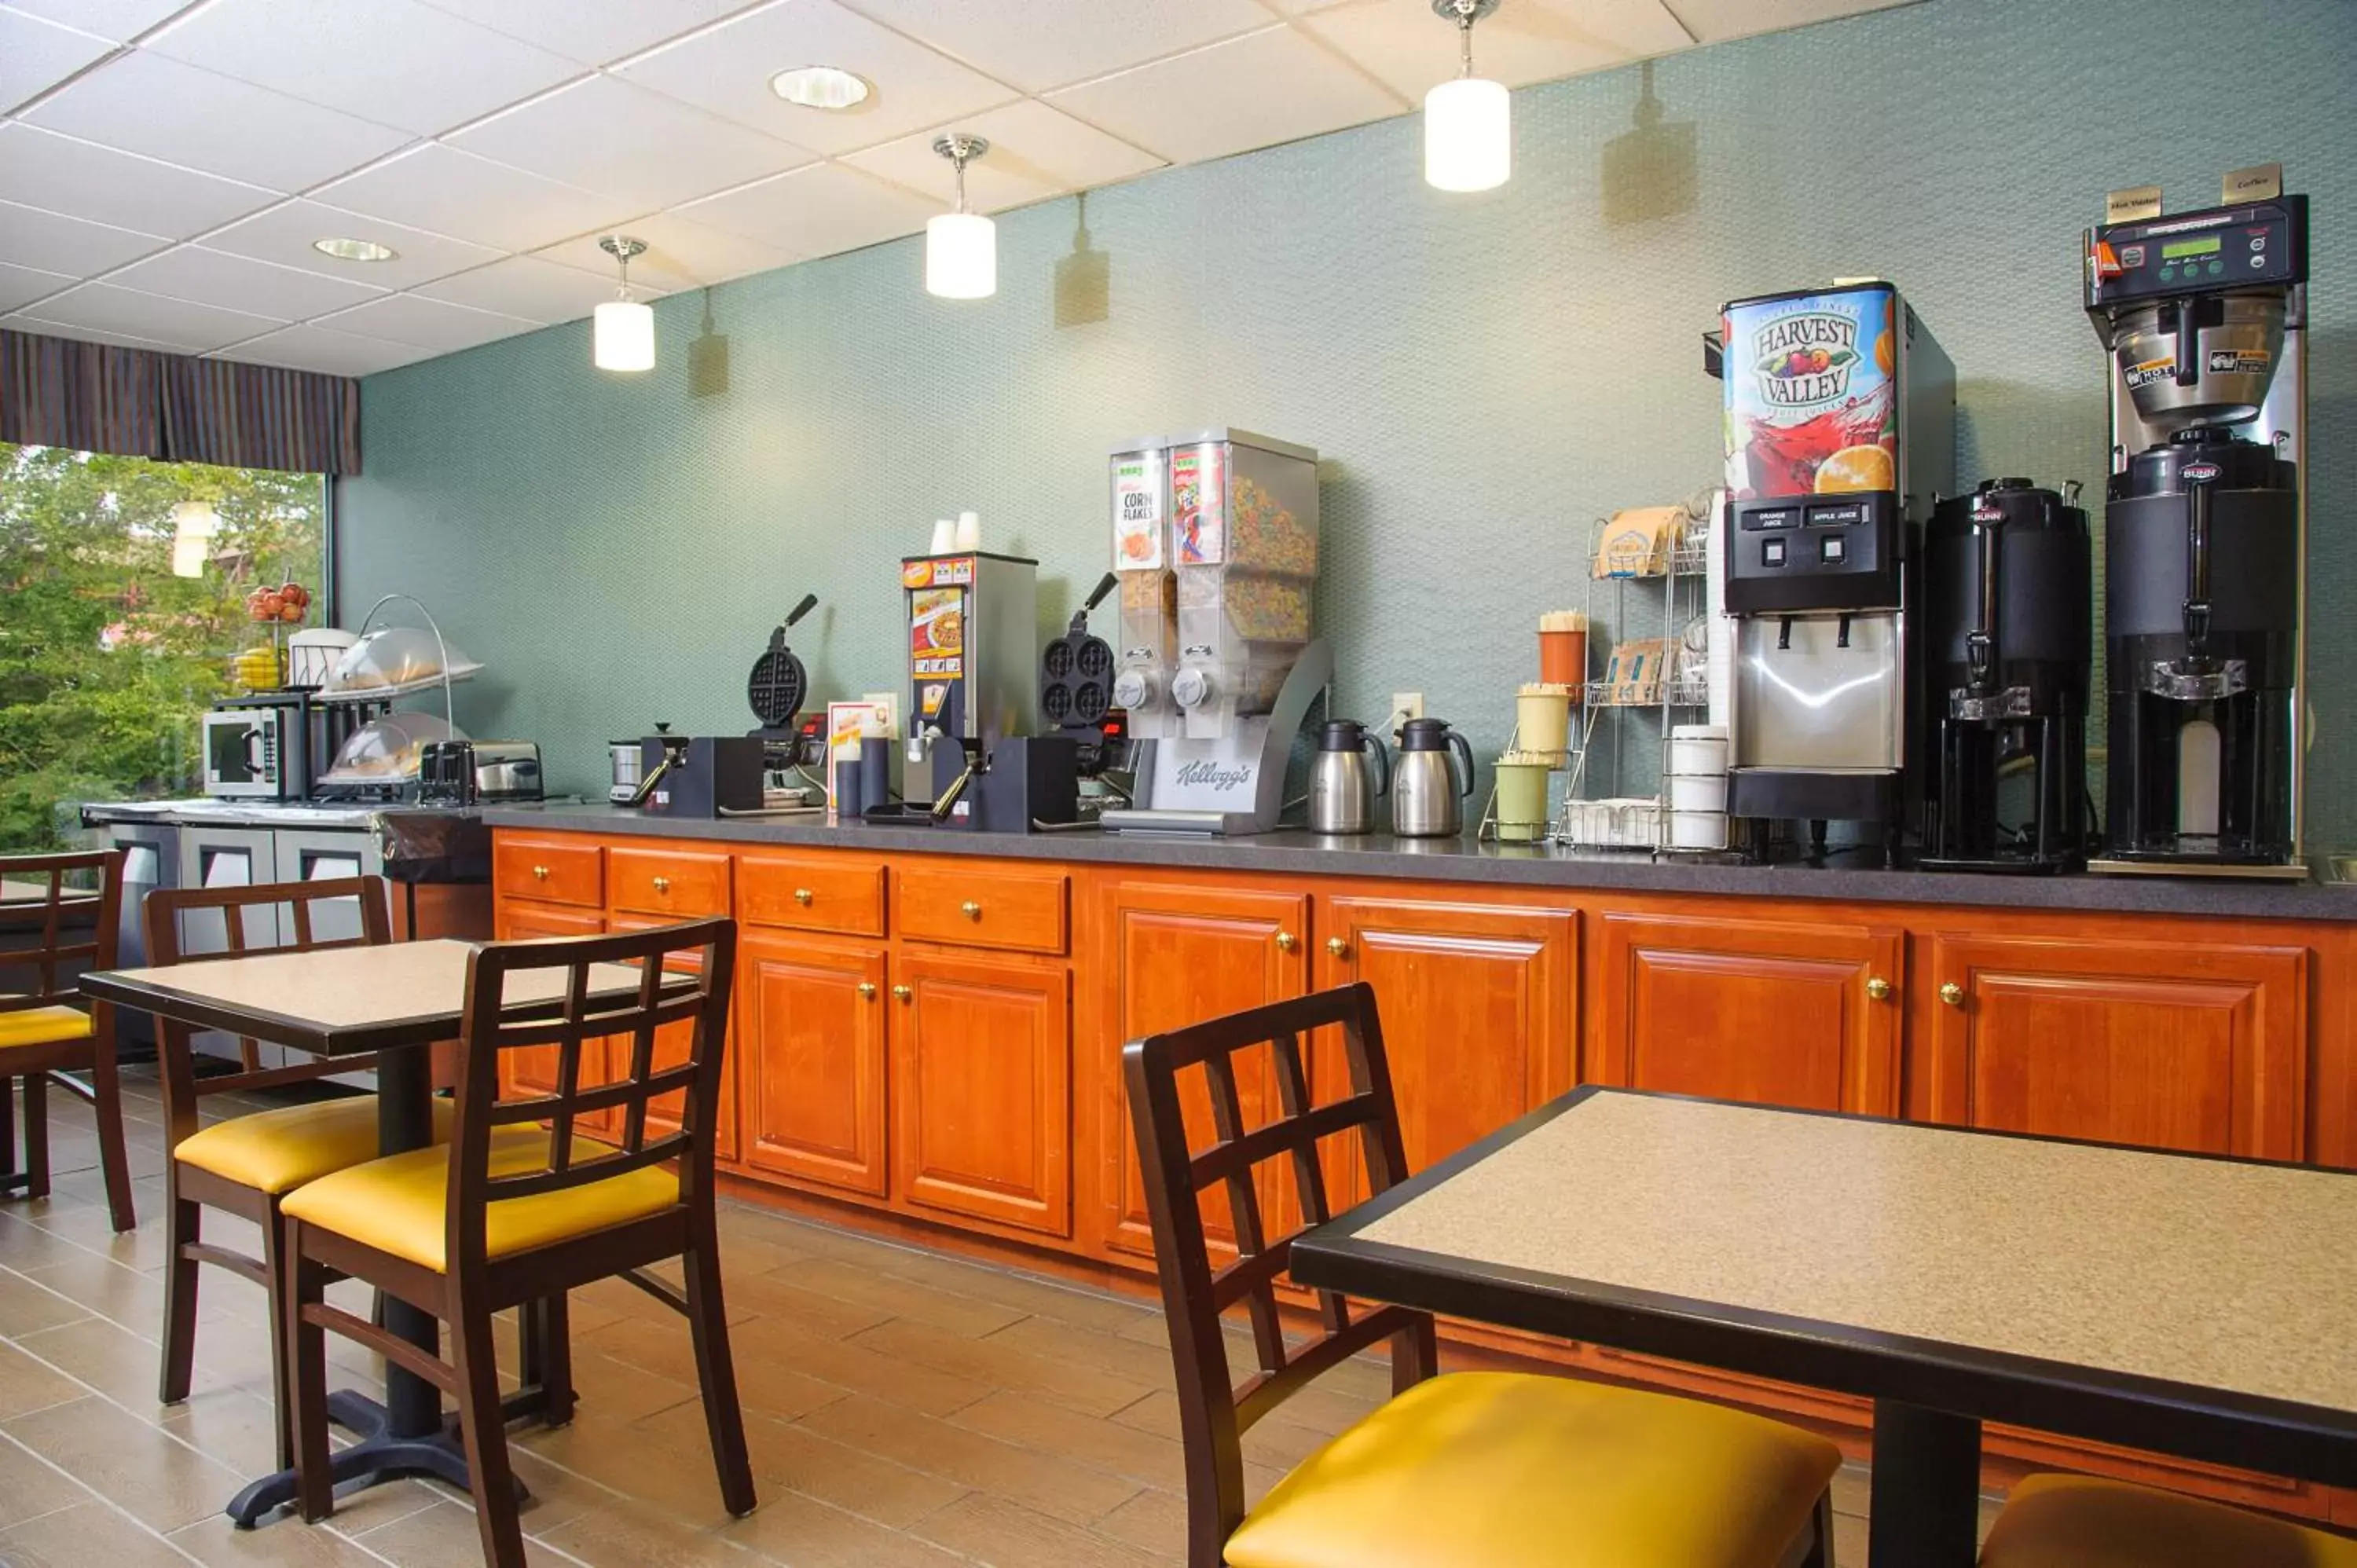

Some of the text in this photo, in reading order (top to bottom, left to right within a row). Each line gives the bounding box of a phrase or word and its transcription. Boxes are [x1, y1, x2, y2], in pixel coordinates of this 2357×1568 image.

[1758, 317, 1854, 357] HARVEST
[1766, 368, 1843, 403] VALLEY
[1124, 492, 1153, 508] CORN
[1124, 507, 1153, 521] FLAKES
[1175, 759, 1252, 791] Kellogg's
